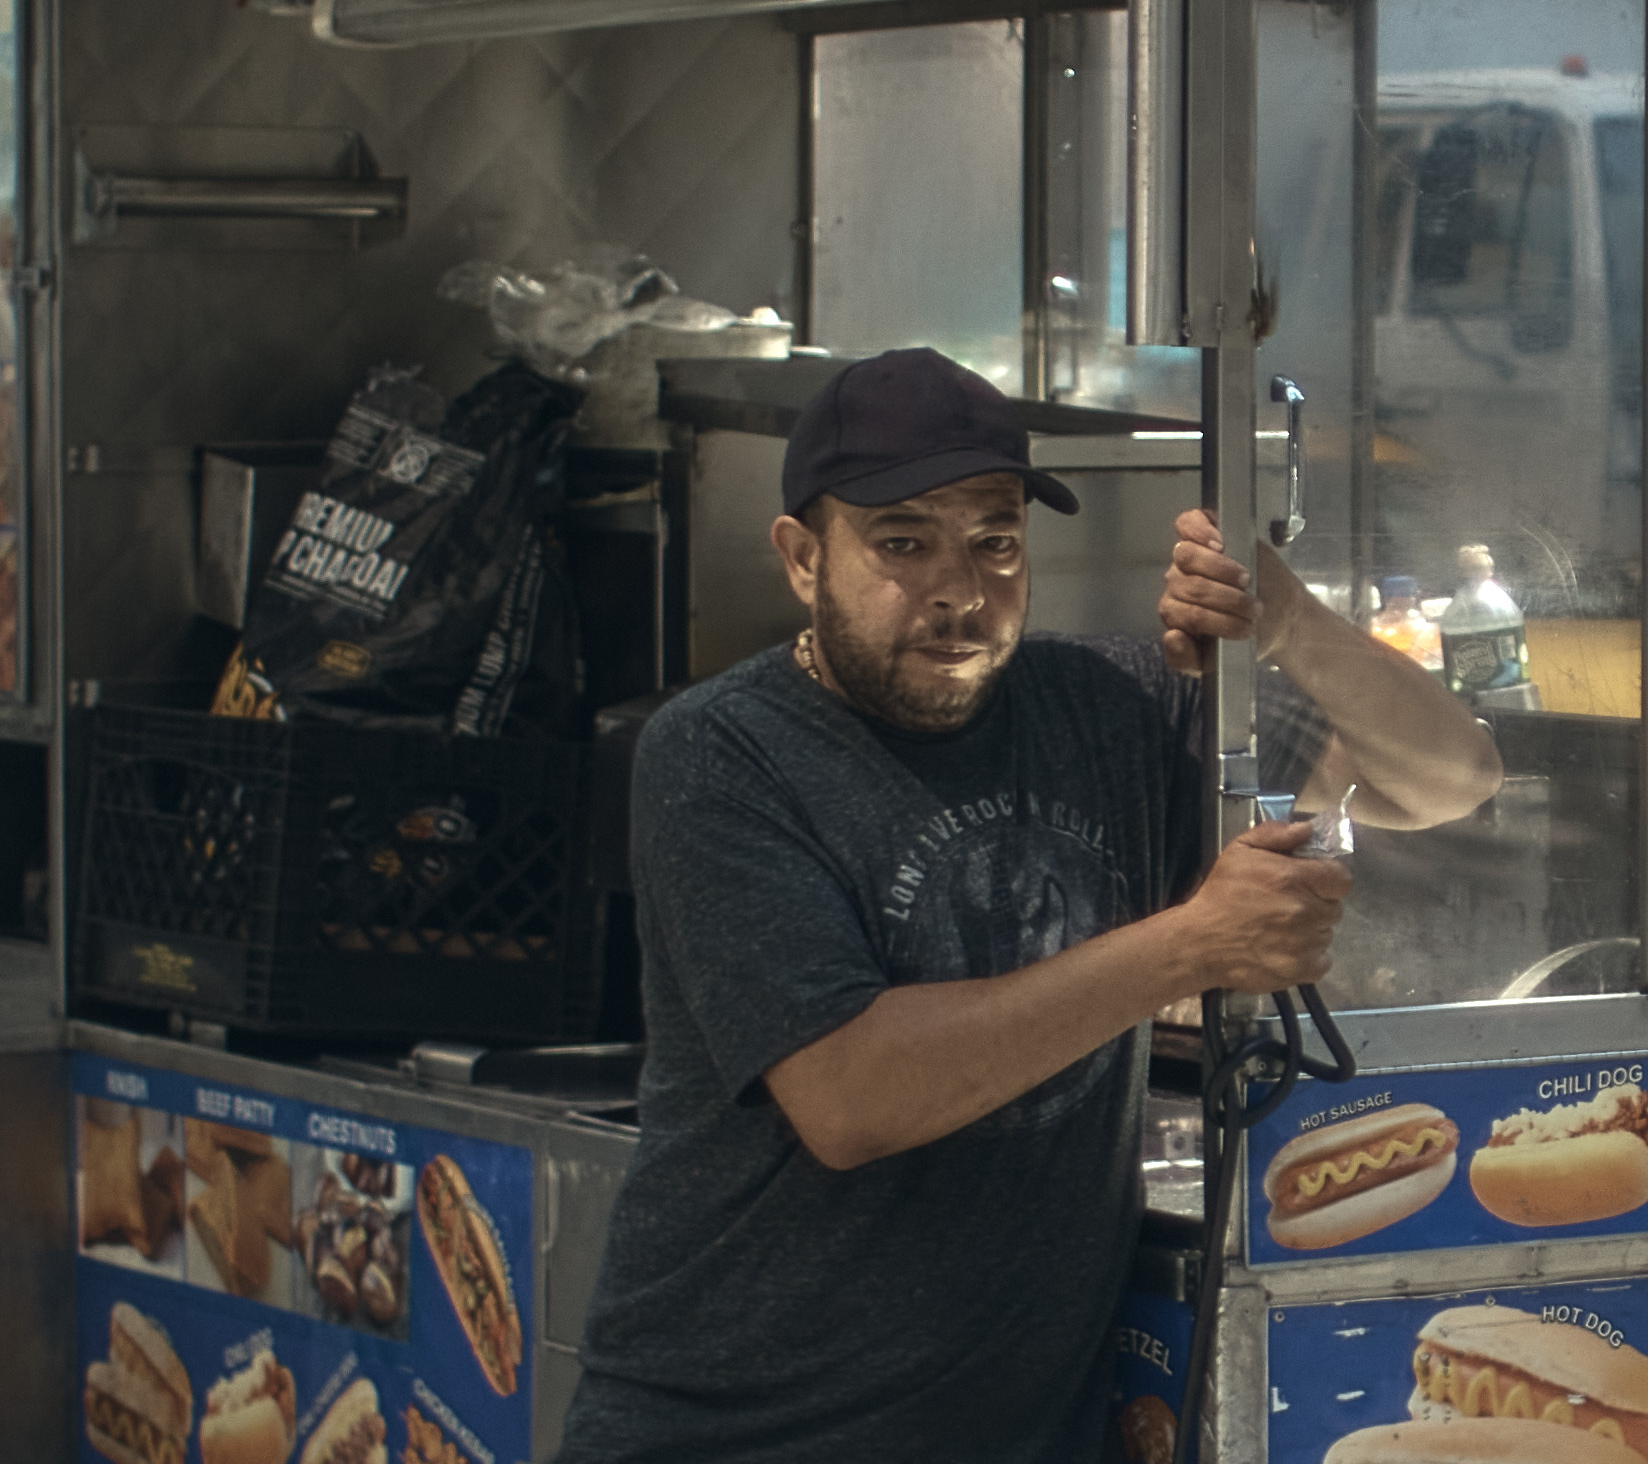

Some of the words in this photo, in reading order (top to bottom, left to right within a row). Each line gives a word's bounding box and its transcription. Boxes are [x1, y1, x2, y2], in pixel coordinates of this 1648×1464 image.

[962, 793, 1013, 825] ROC
[1538, 1072, 1592, 1100] CHILI
[1598, 1064, 1644, 1089] DOG
[196, 1087, 231, 1118] BEEF
[233, 1095, 276, 1127] PATTY
[1301, 1112, 1328, 1132] HOT
[1330, 1091, 1393, 1121] SAUSAGE
[308, 1111, 397, 1155] CHESTNUTS
[1542, 1305, 1583, 1325] HOT
[1585, 1310, 1624, 1348] DOG
[1117, 1326, 1173, 1377] ETZEL
